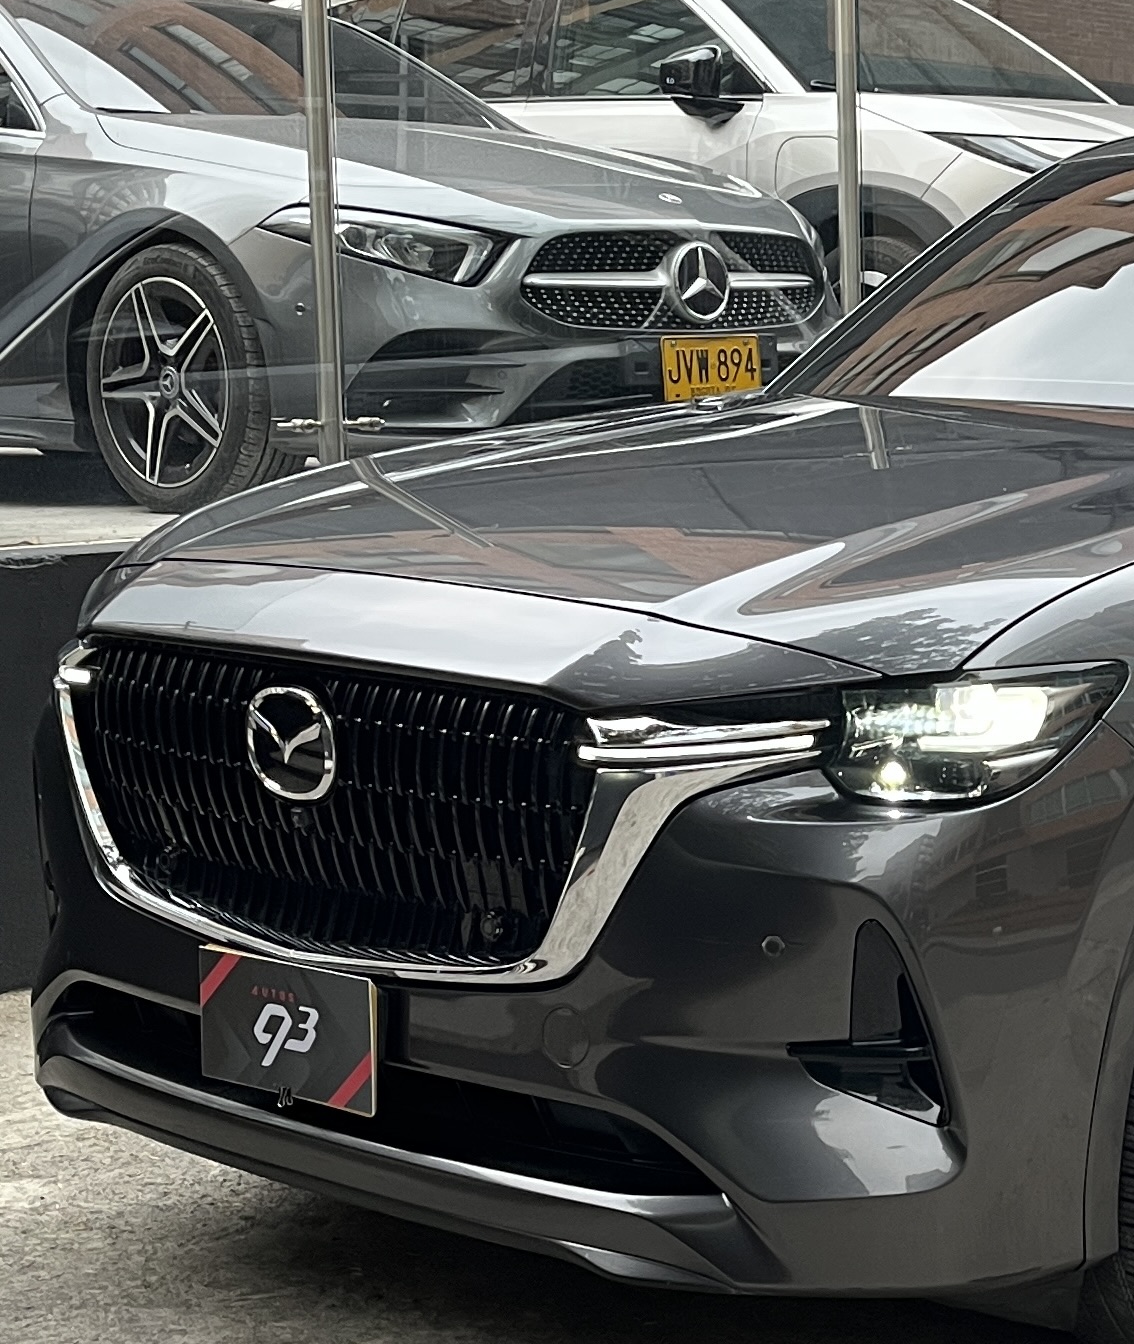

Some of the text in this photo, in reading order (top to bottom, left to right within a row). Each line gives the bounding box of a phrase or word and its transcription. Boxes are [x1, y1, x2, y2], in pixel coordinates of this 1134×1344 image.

[717, 348, 757, 383] 894
[251, 985, 295, 1003] AUTOS
[253, 1003, 319, 1067] 93
